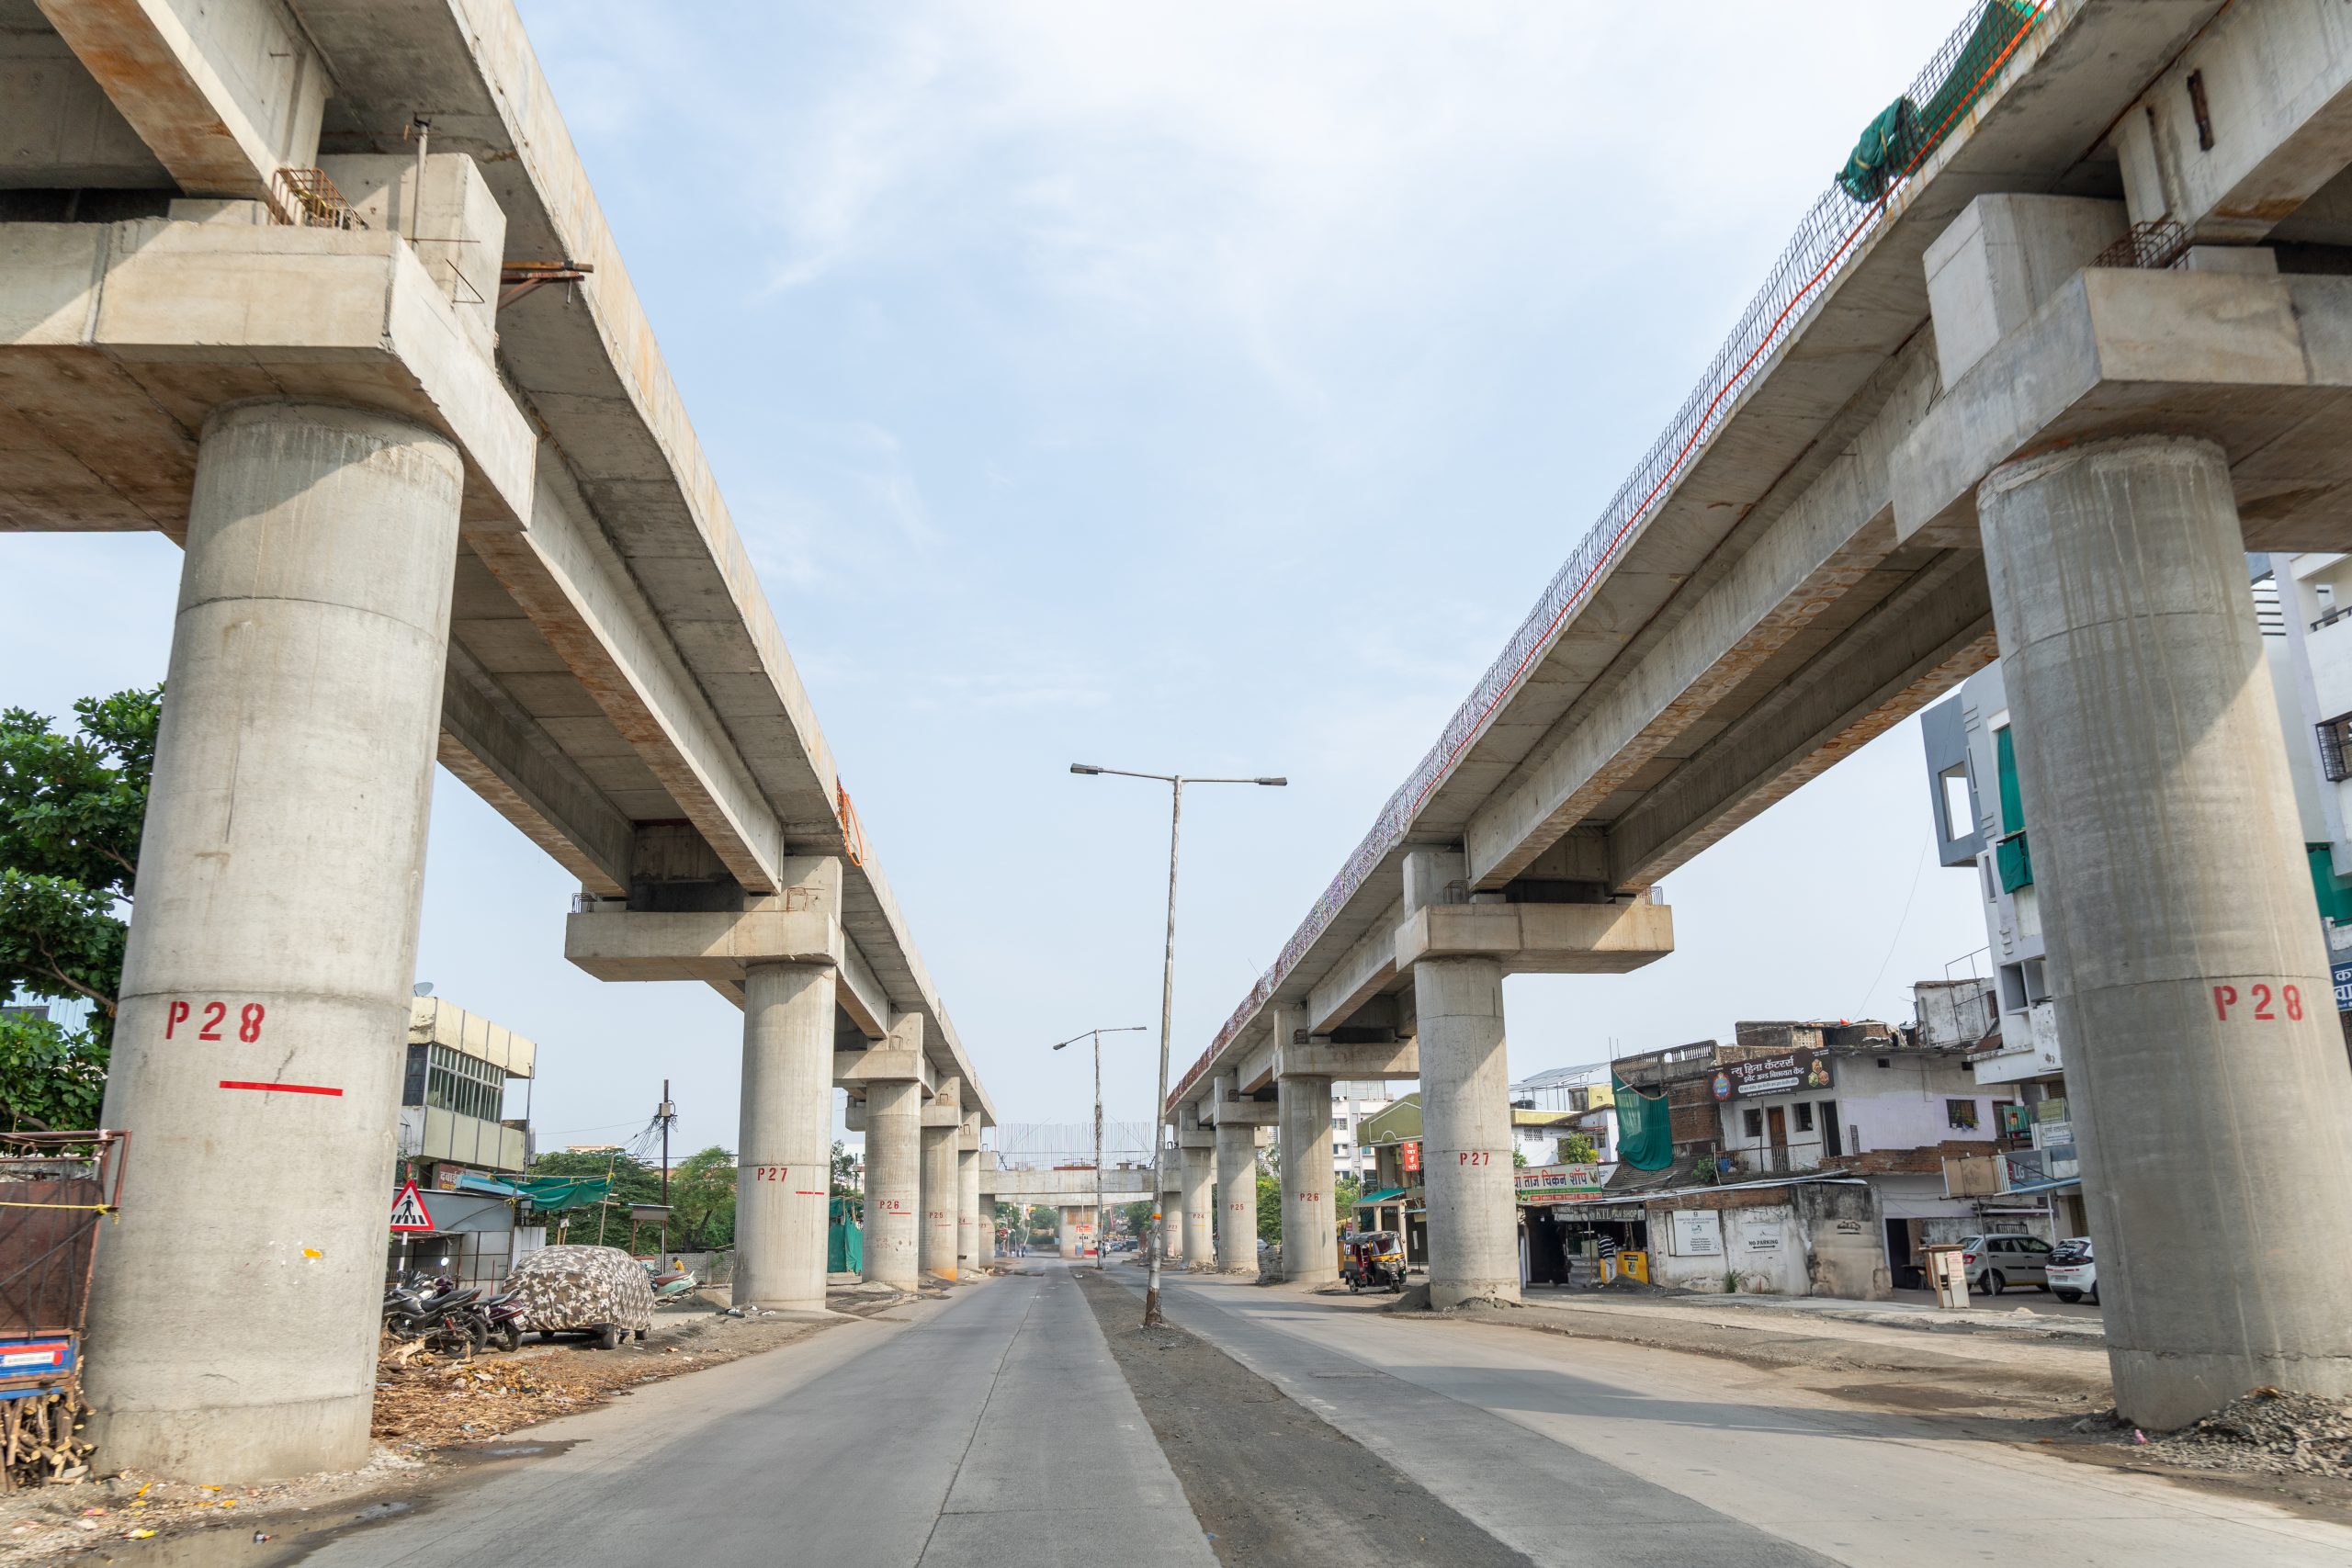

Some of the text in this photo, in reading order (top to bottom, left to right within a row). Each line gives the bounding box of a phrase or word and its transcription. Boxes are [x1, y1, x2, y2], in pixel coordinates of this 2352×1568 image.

[2213, 984, 2303, 1021] P28
[165, 1000, 266, 1043] P28
[1460, 1151, 1490, 1167] P27
[757, 1167, 788, 1183] P27
[1523, 1175, 1539, 1188] ताज
[1542, 1168, 1566, 1186] चिकन
[1569, 1167, 1588, 1185] शॉप
[2013, 1164, 2025, 1179] LG
[879, 1200, 899, 1210] P26
[1299, 1192, 1319, 1202] P26
[1623, 1209, 1637, 1218] SHOP
